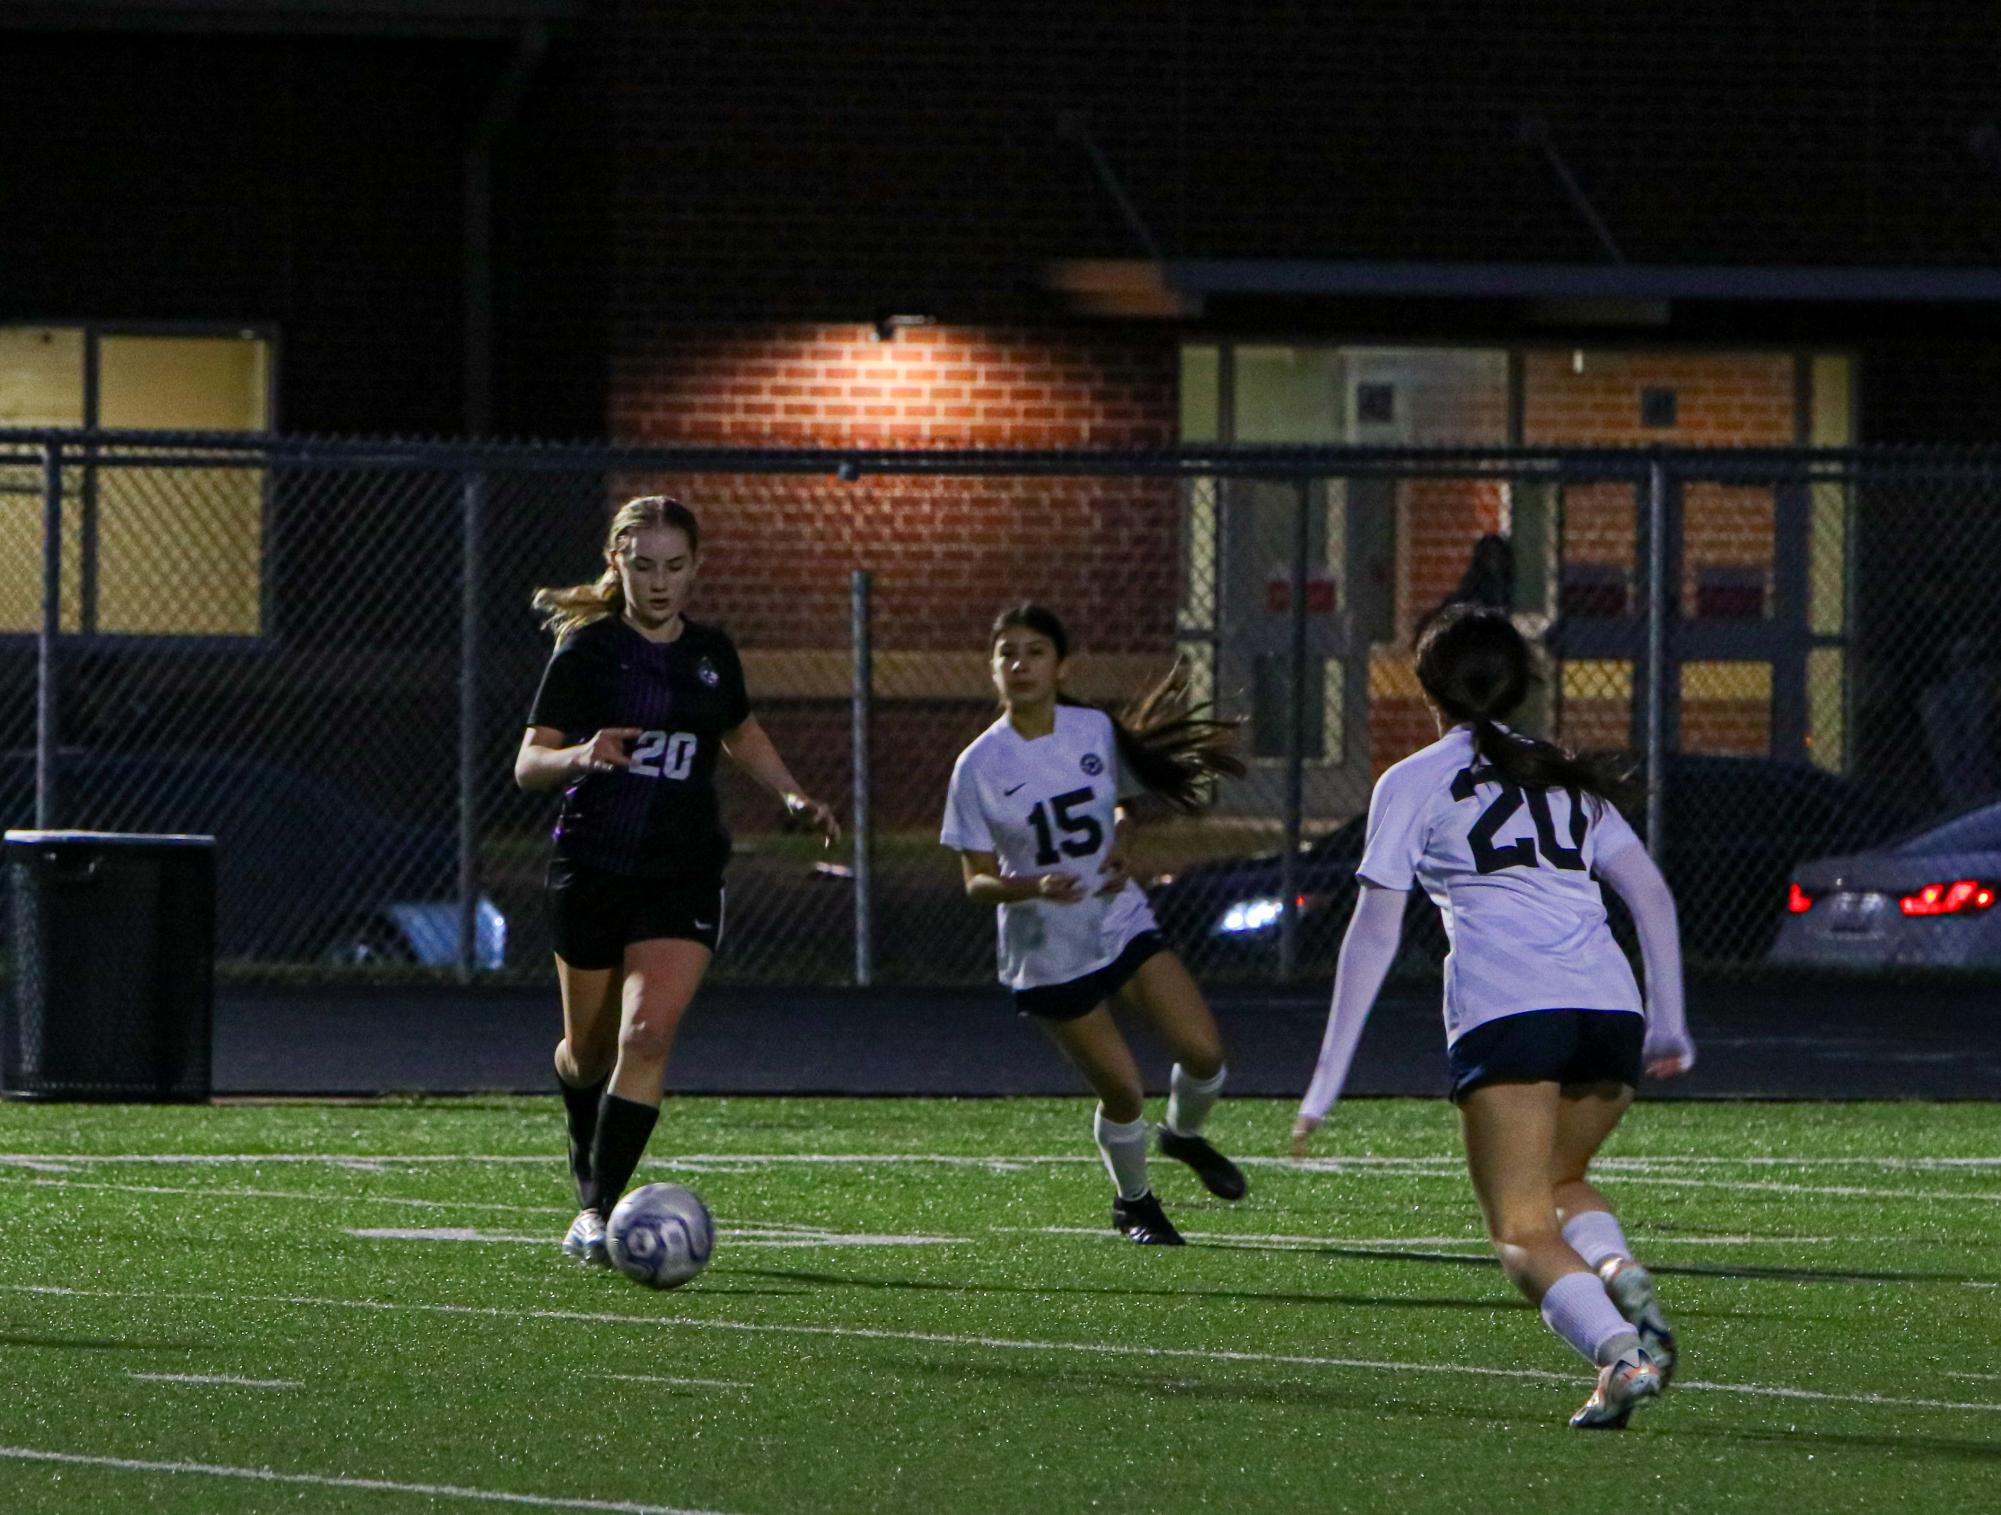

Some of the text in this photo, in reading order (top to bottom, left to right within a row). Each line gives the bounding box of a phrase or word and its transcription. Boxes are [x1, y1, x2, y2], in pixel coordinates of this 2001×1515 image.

[629, 731, 697, 780] 20
[1027, 786, 1103, 867] 15
[1450, 765, 1588, 874] 20
